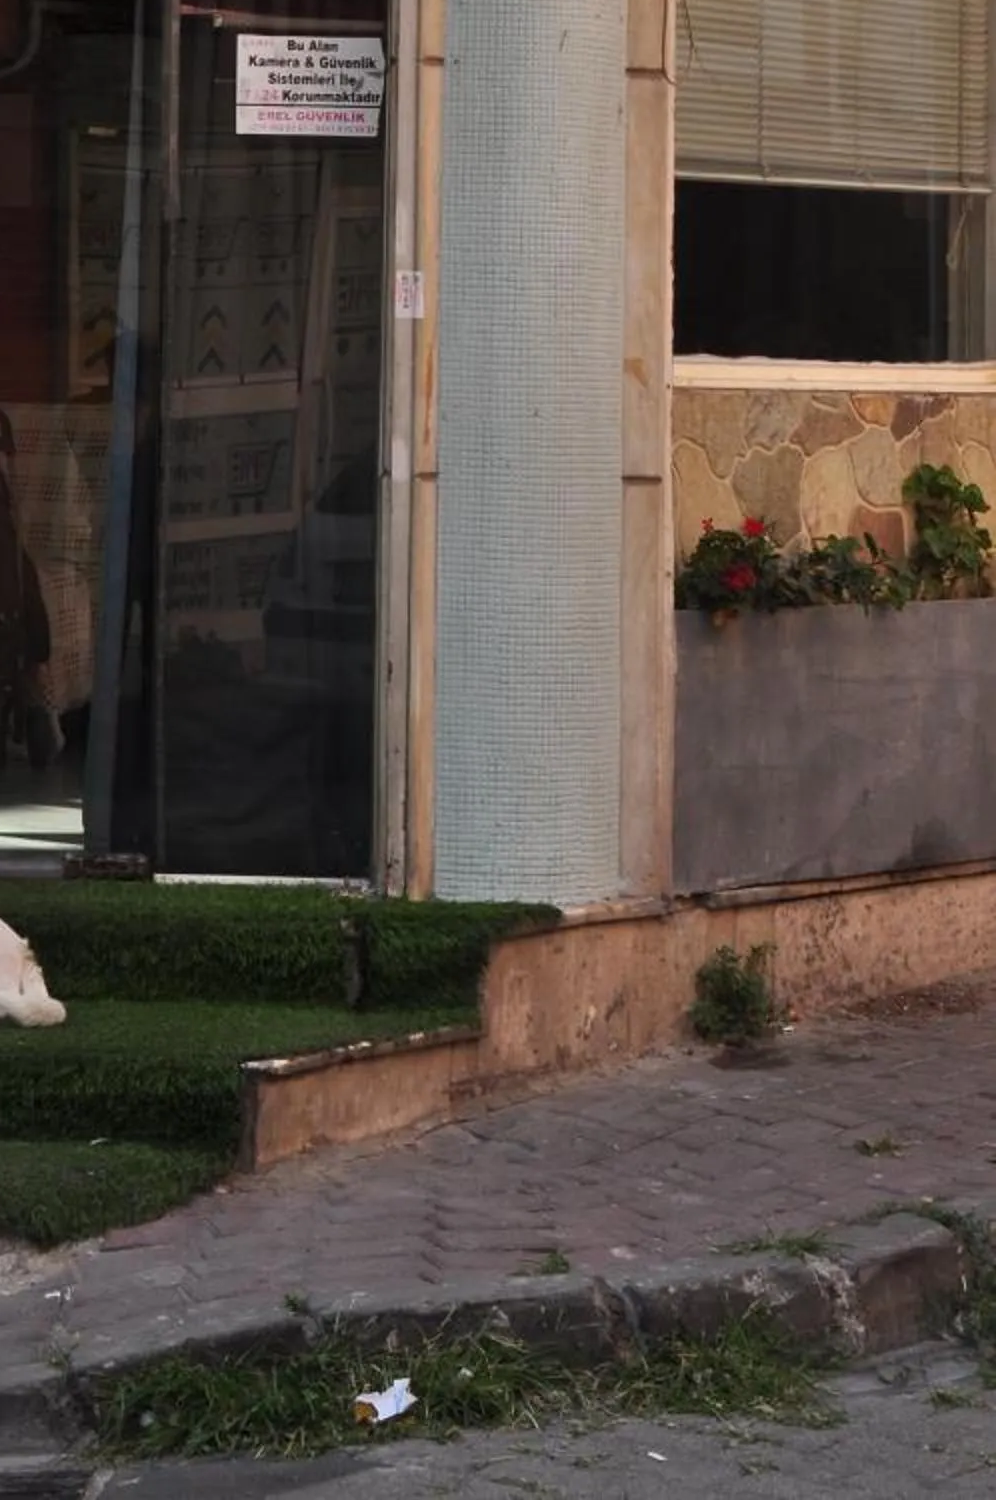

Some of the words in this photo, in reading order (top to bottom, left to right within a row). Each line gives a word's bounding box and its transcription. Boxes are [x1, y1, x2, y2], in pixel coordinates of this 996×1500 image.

[287, 39, 305, 51] Bu
[309, 40, 339, 52] Alan
[249, 54, 300, 68] Kamera
[305, 56, 315, 68] &
[319, 55, 377, 69] Güvenlik
[267, 72, 335, 85] Sistemleri
